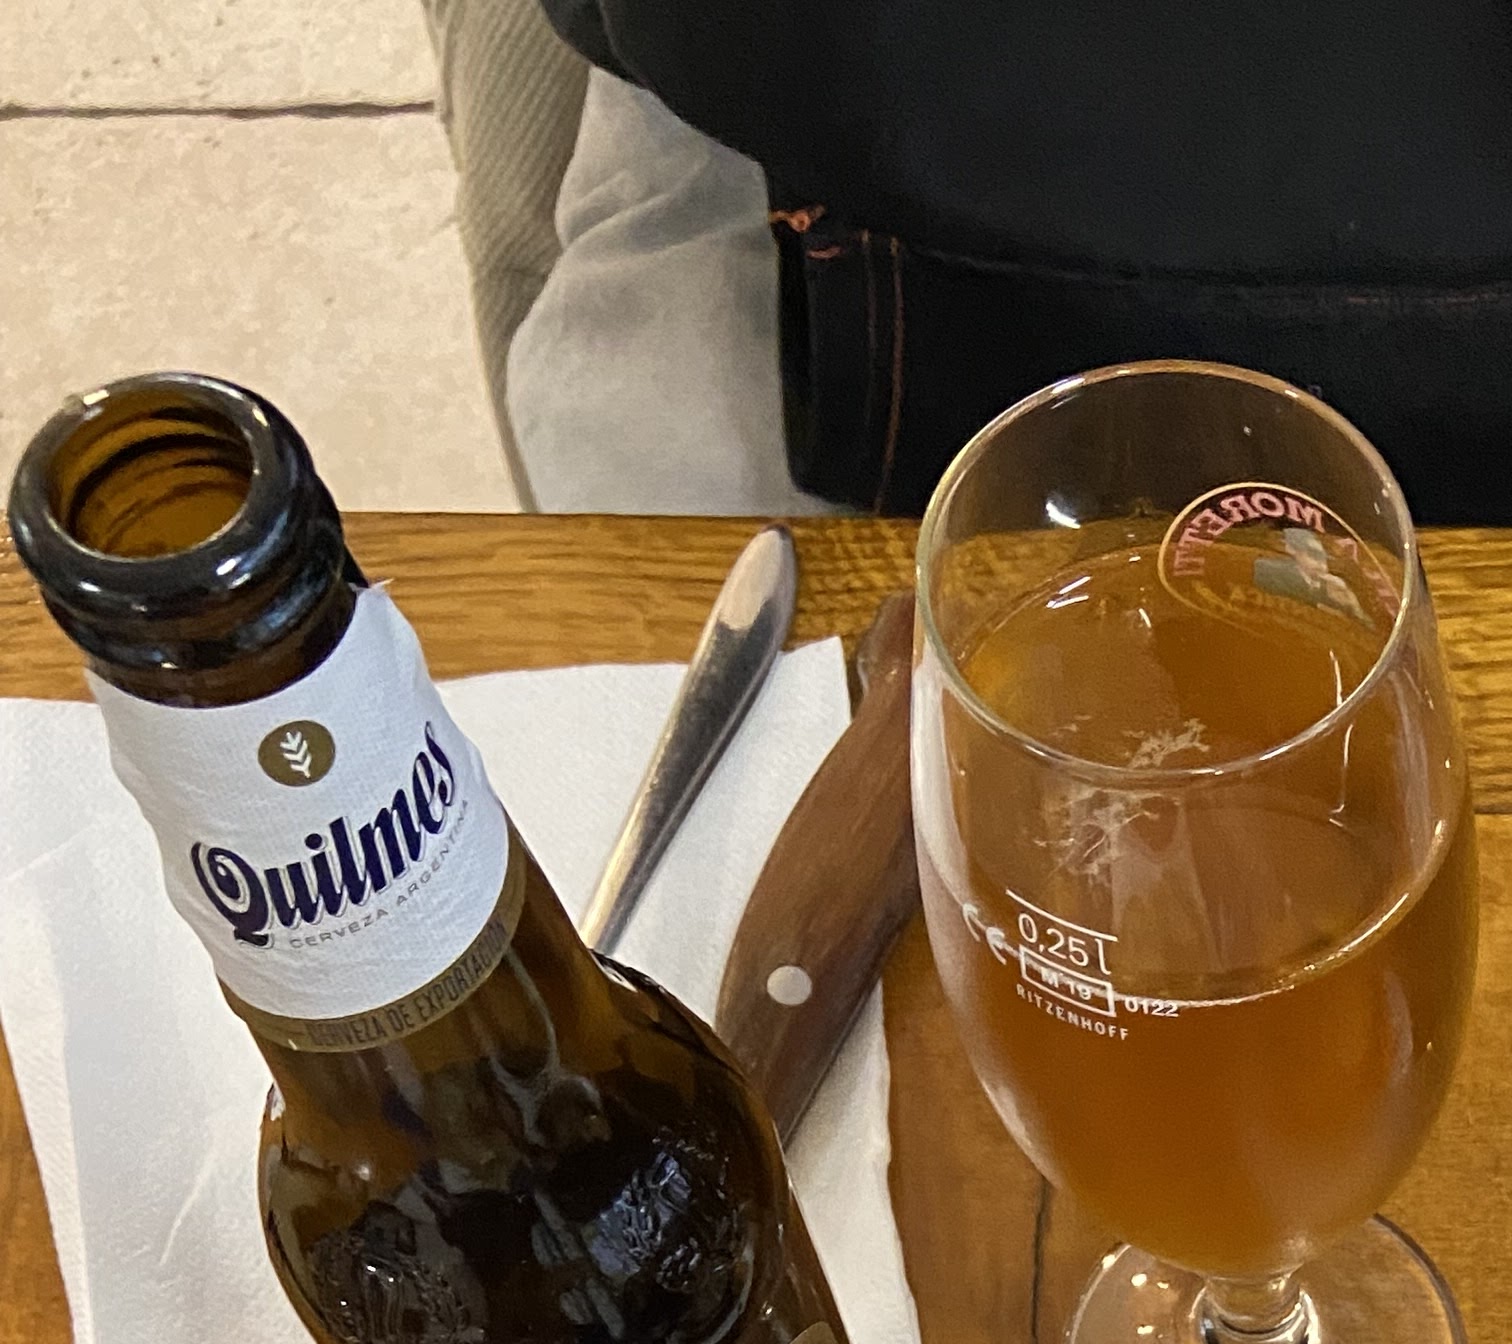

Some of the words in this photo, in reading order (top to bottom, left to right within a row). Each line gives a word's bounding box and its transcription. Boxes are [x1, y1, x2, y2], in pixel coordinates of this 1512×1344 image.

[190, 720, 457, 947] Quilmes
[289, 908, 389, 949] CERVEZA
[1018, 912, 1089, 967] 0,25
[387, 1003, 416, 1033] DE
[1016, 983, 1130, 1041] RITZENHOFF
[1124, 998, 1179, 1018] 0122
